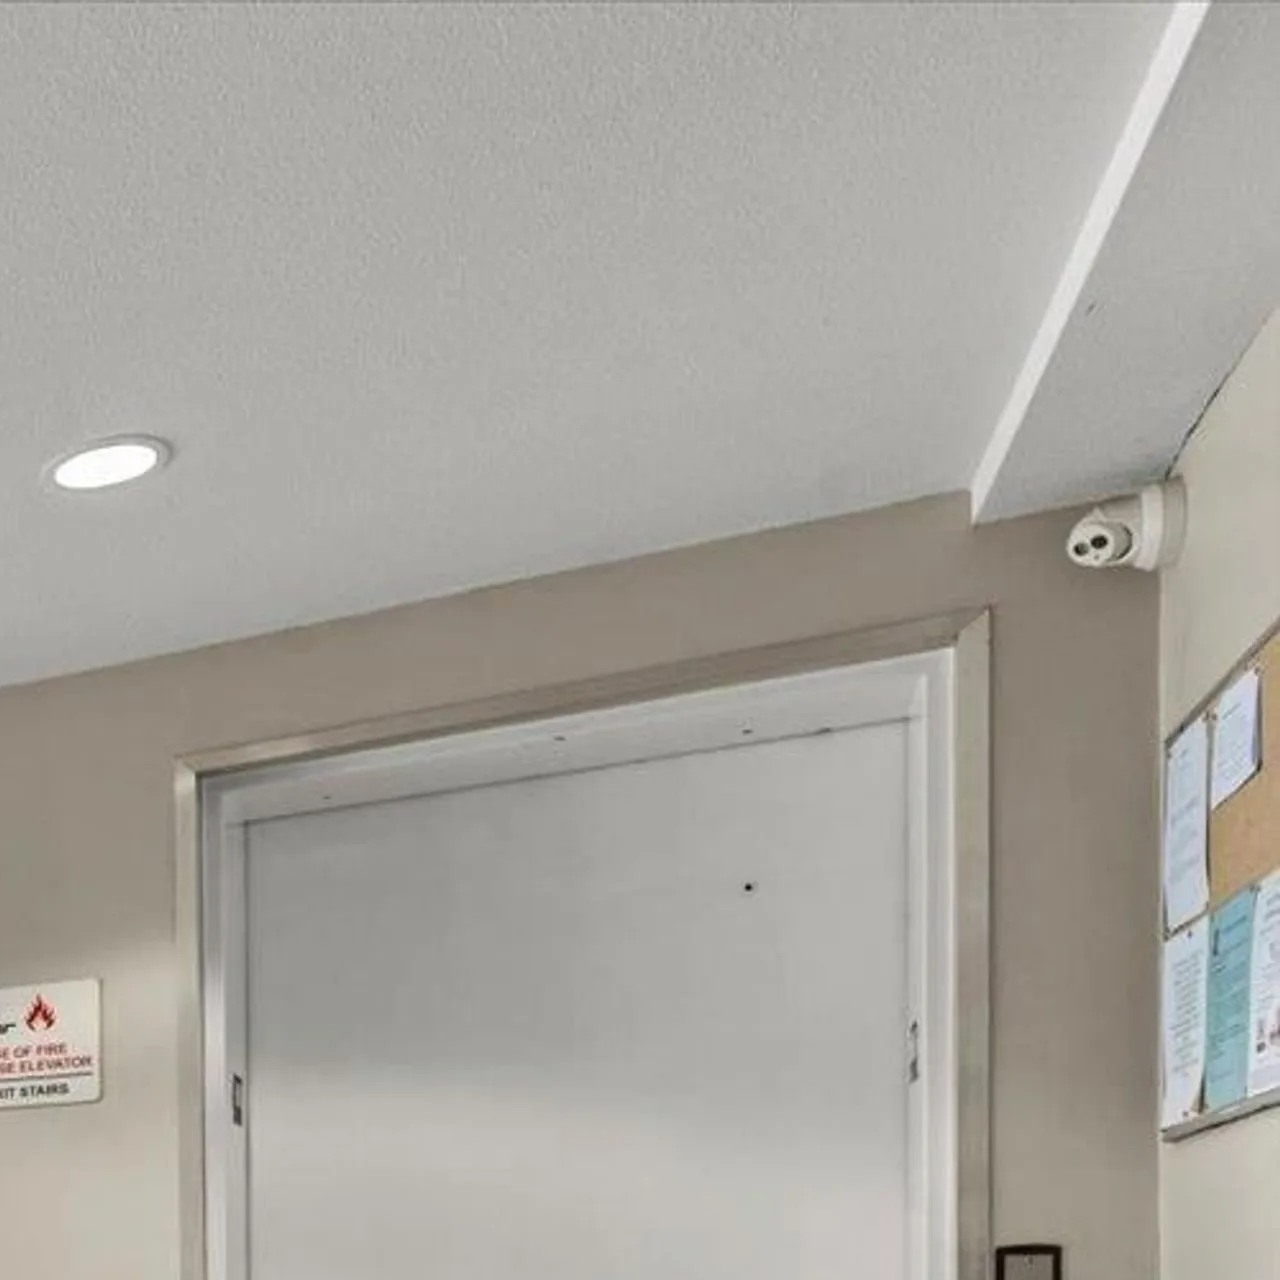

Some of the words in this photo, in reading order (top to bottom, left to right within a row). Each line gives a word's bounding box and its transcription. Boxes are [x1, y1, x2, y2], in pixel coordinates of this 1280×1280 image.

[13, 1045, 30, 1057] OF
[36, 1042, 68, 1056] FIRE
[20, 1056, 93, 1073] ELEVATOR
[19, 1083, 71, 1097] STAIRS
